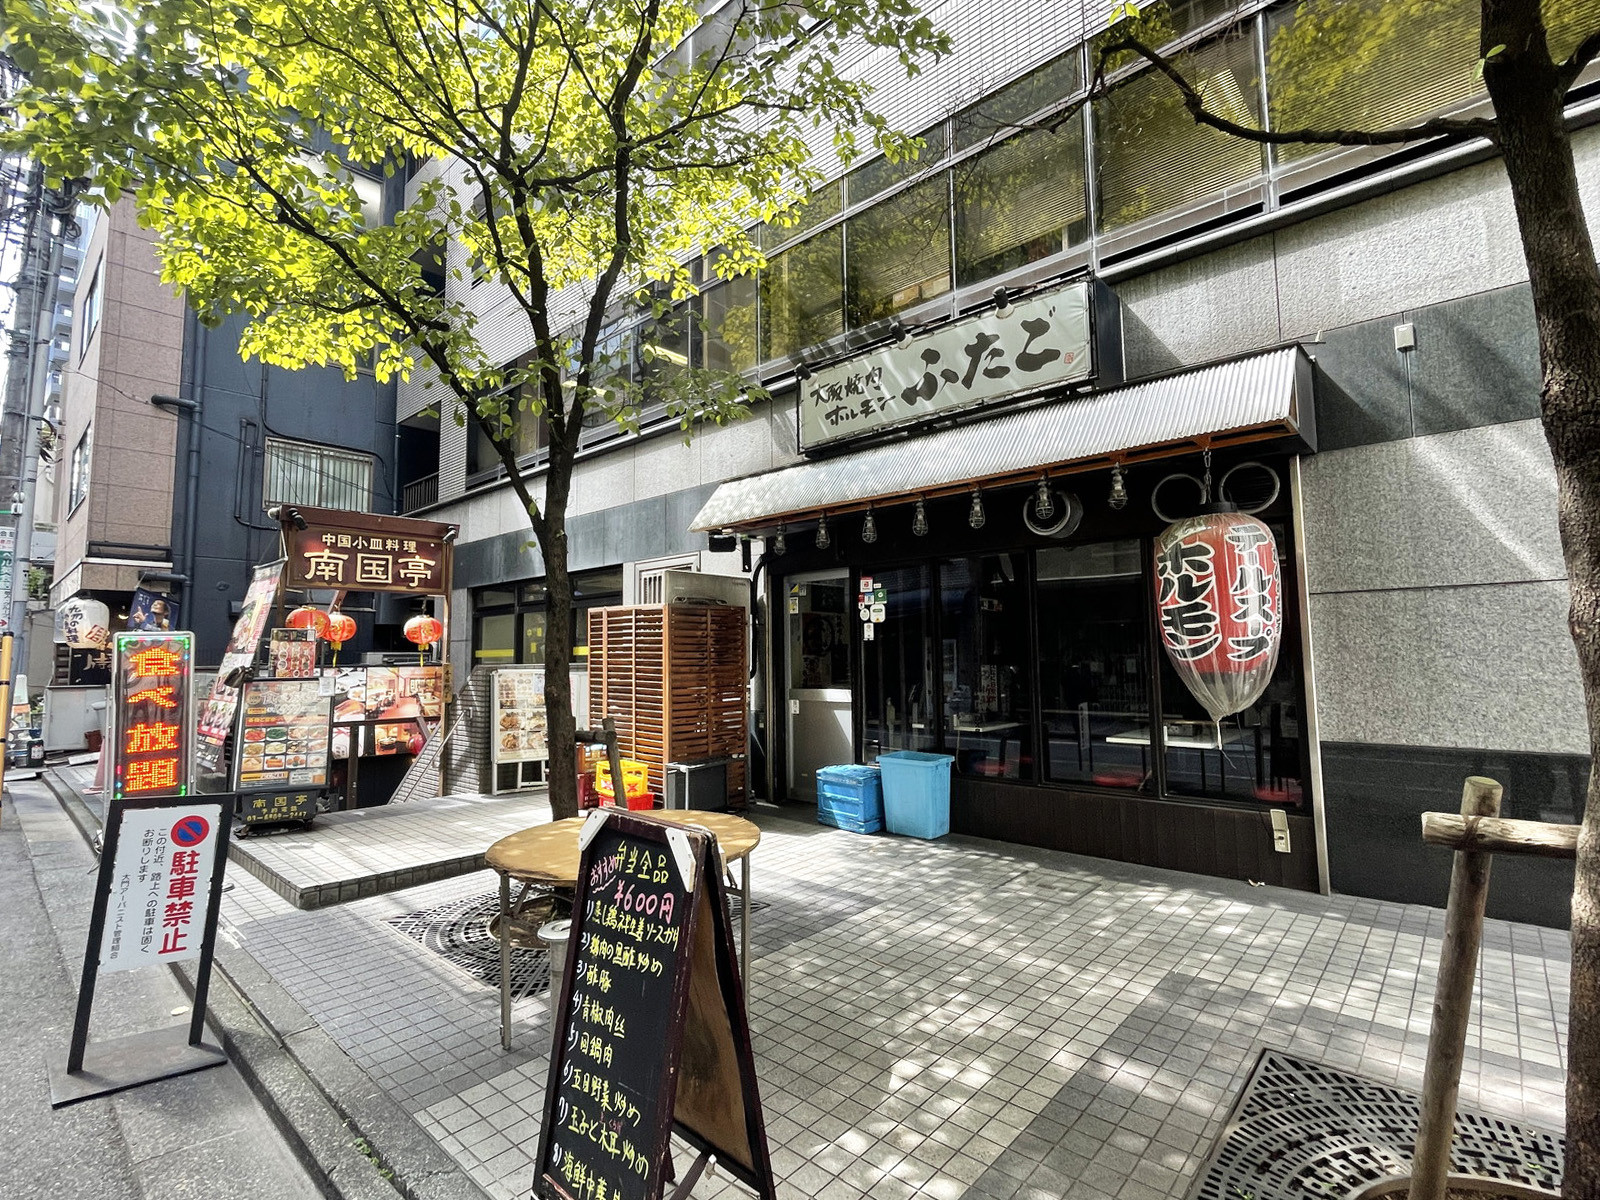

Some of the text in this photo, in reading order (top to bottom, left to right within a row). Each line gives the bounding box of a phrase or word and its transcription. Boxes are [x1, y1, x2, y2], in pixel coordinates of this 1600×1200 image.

[900, 306, 1061, 406] ふたご
[809, 366, 883, 407] 大阪焼肉
[825, 395, 897, 427] ホルモン
[321, 532, 417, 553] 中国小皿料理
[303, 548, 436, 587] 南国亭
[1156, 541, 1222, 661] ホルモン
[126, 647, 181, 792] 食べ放題
[138, 829, 155, 883] お断りします
[590, 855, 617, 887] おすすめ
[613, 841, 669, 884] 弁当全品
[158, 850, 200, 954] 駐車禁止
[614, 880, 675, 924] ¥600円
